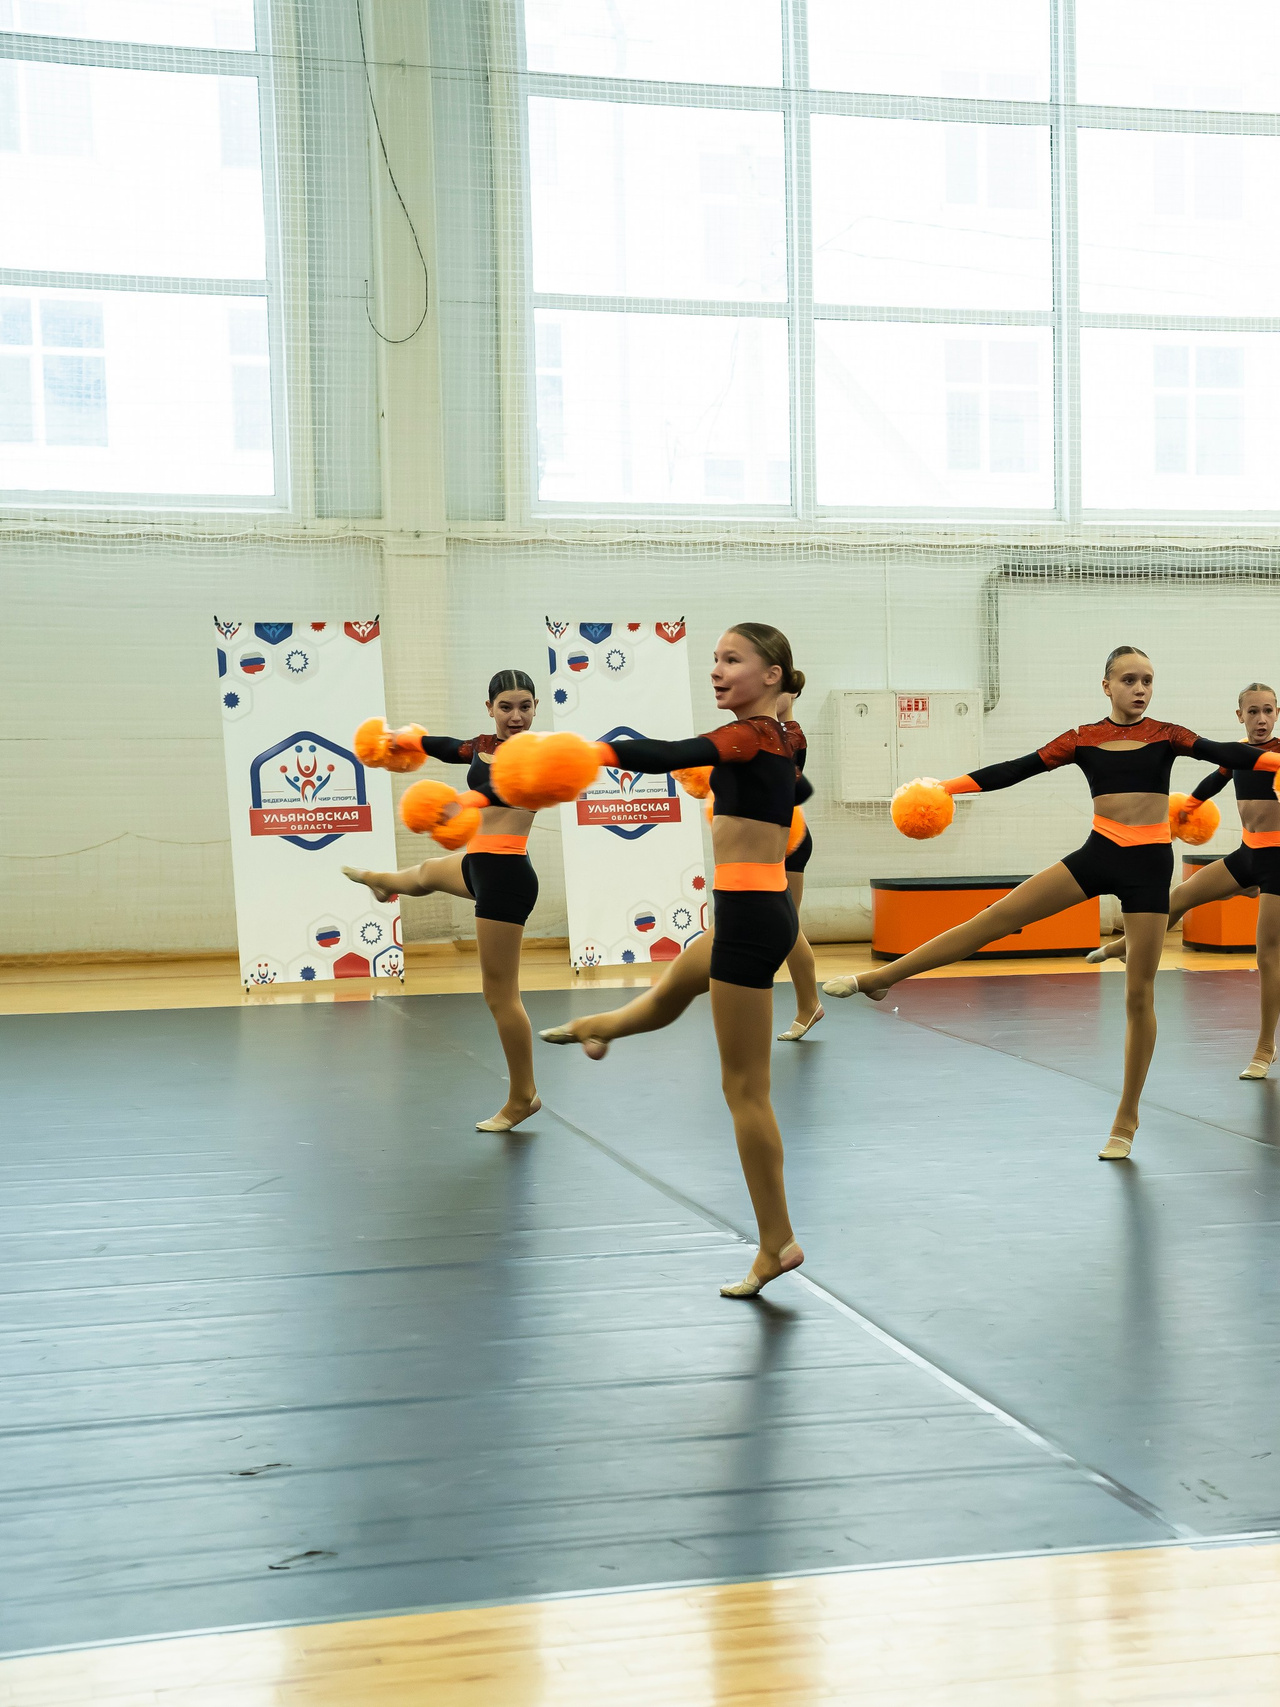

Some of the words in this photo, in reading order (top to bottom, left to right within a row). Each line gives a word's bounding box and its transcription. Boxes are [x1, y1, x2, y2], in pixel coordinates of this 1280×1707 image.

[587, 802, 670, 814] УЛЬЯНОВСКАЯ
[262, 810, 359, 824] УЛЬЯНОВСКАЯ
[611, 813, 648, 822] ОБЛАСТЬ
[290, 823, 334, 832] ОБЛАСТЬ
